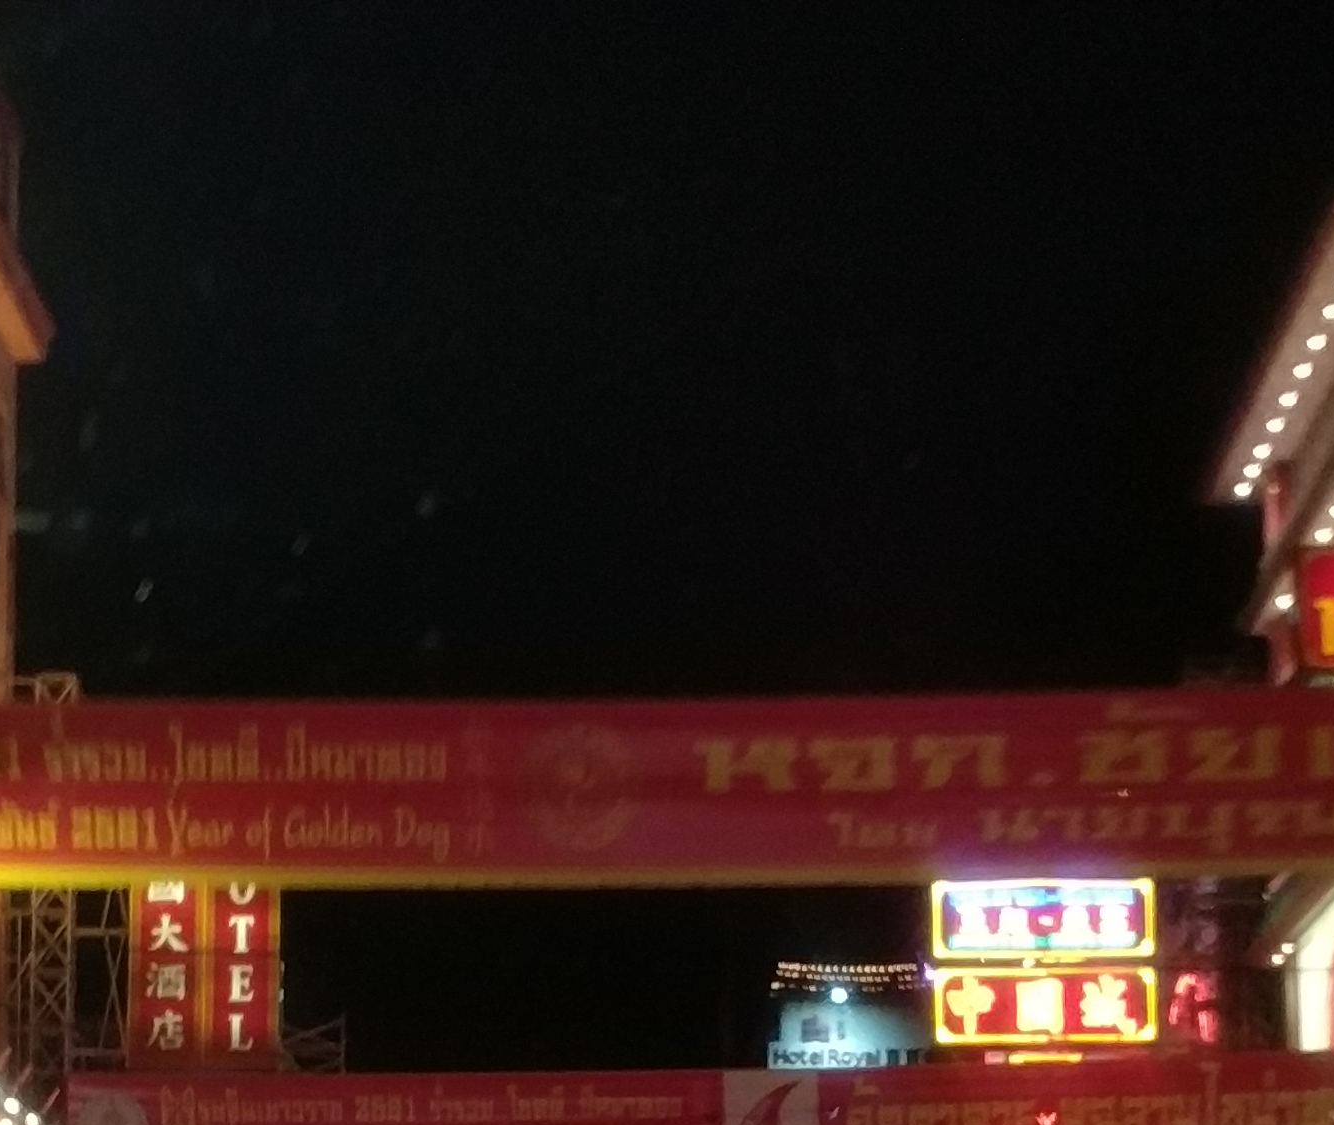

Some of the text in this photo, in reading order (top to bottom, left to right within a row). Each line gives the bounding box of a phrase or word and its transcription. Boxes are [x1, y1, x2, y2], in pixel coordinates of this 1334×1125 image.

[167, 797, 234, 858] Year
[245, 801, 274, 862] of
[283, 801, 382, 850] Golden
[394, 804, 451, 863] Dog
[773, 1048, 824, 1066] Hotel
